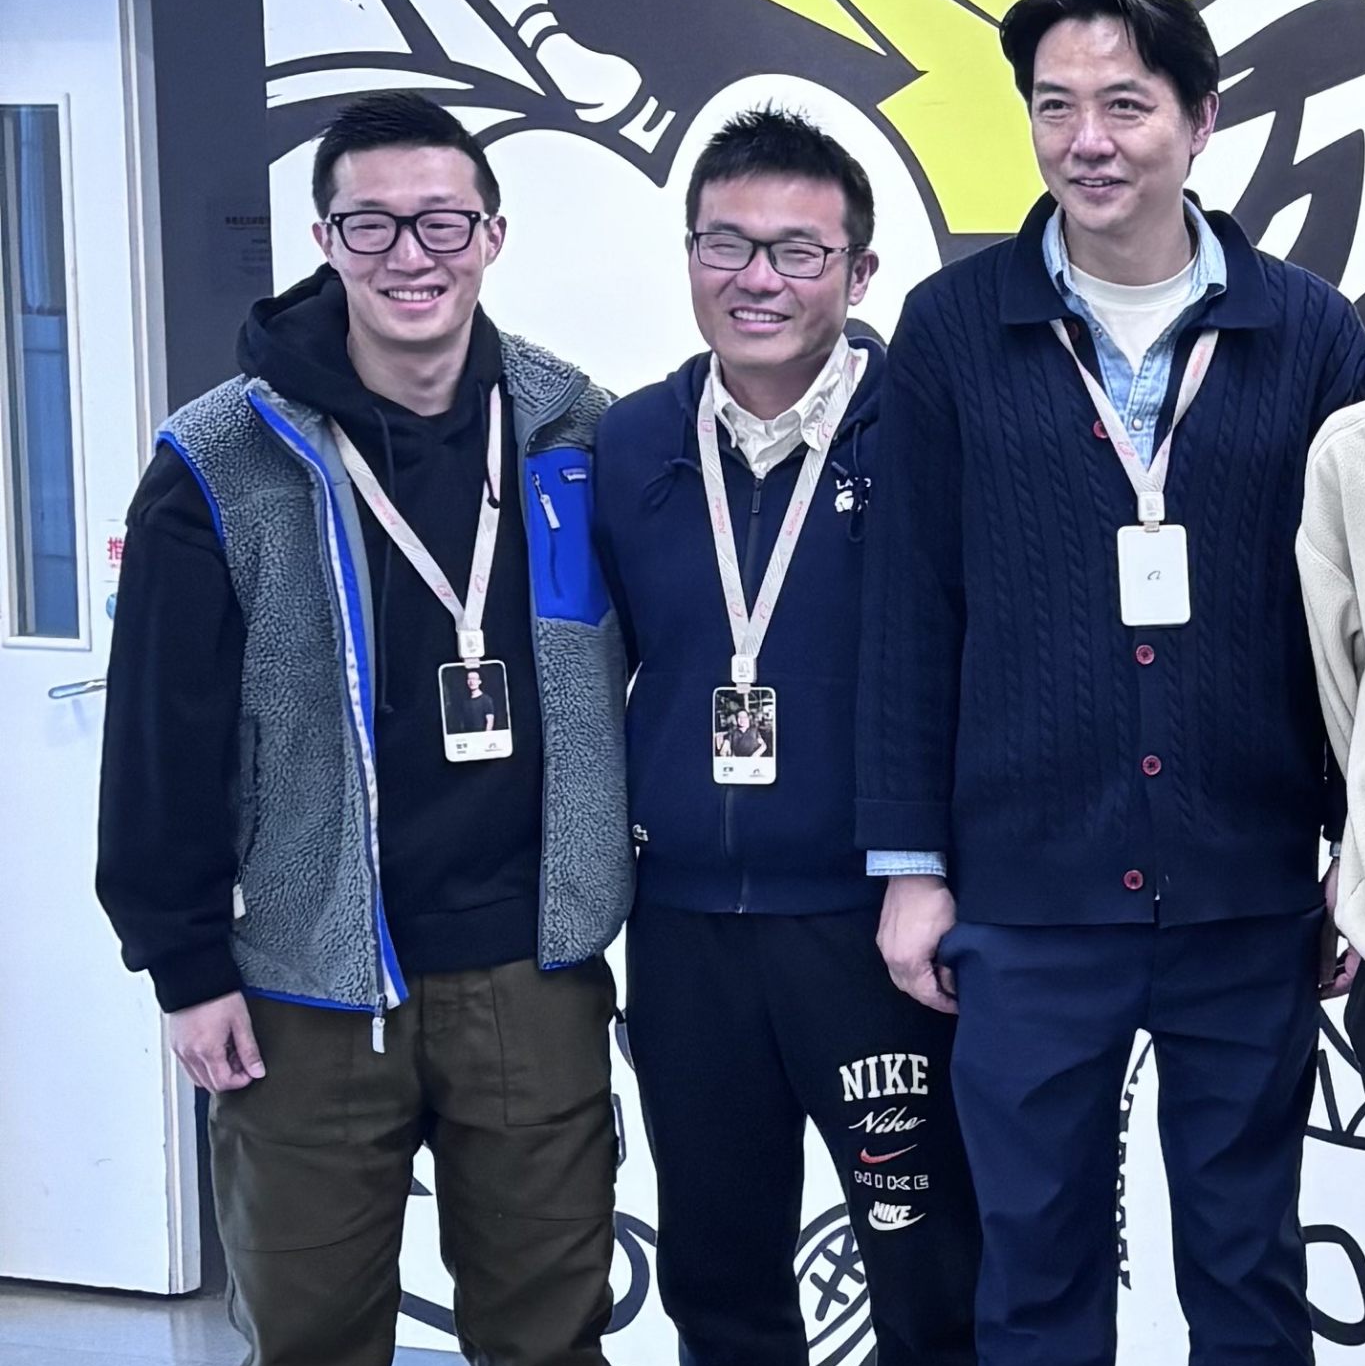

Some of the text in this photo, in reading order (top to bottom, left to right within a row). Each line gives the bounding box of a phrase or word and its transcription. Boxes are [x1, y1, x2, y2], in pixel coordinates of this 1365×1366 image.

[839, 1053, 929, 1102] NIKE
[848, 1106, 926, 1135] Nike
[872, 1201, 912, 1225] NIKE
